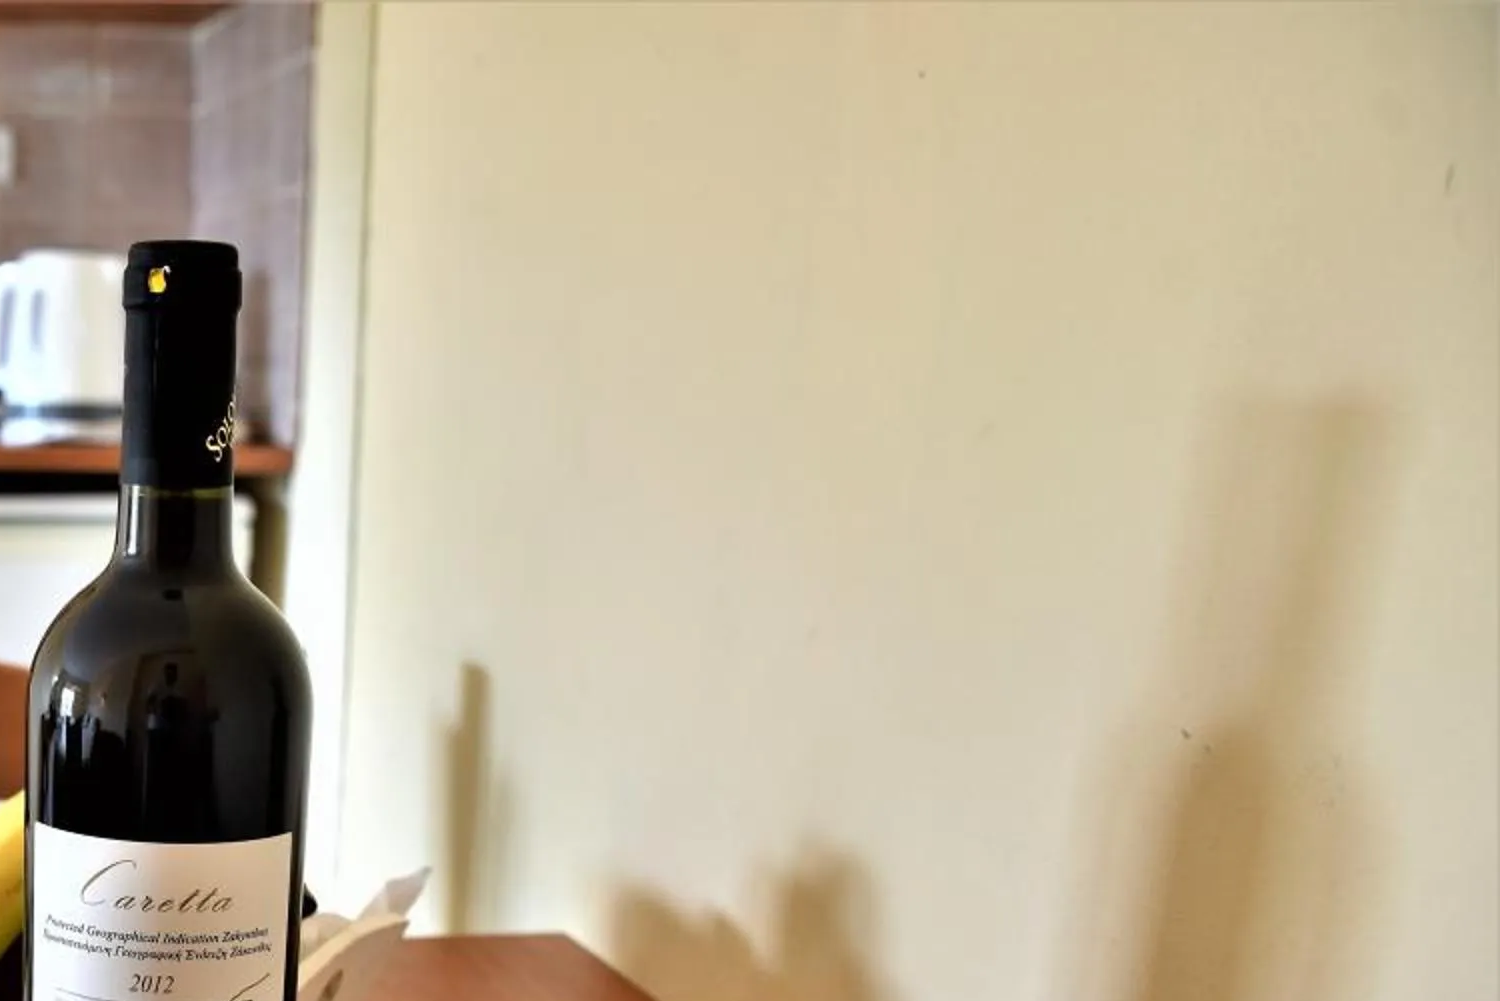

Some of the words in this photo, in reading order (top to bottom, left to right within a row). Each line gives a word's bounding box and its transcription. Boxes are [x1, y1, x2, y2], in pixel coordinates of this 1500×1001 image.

[79, 859, 233, 913] Caretta
[45, 913, 85, 934] Protected
[86, 925, 160, 944] Geographical
[162, 931, 219, 945] Indication
[129, 973, 175, 994] 2012
